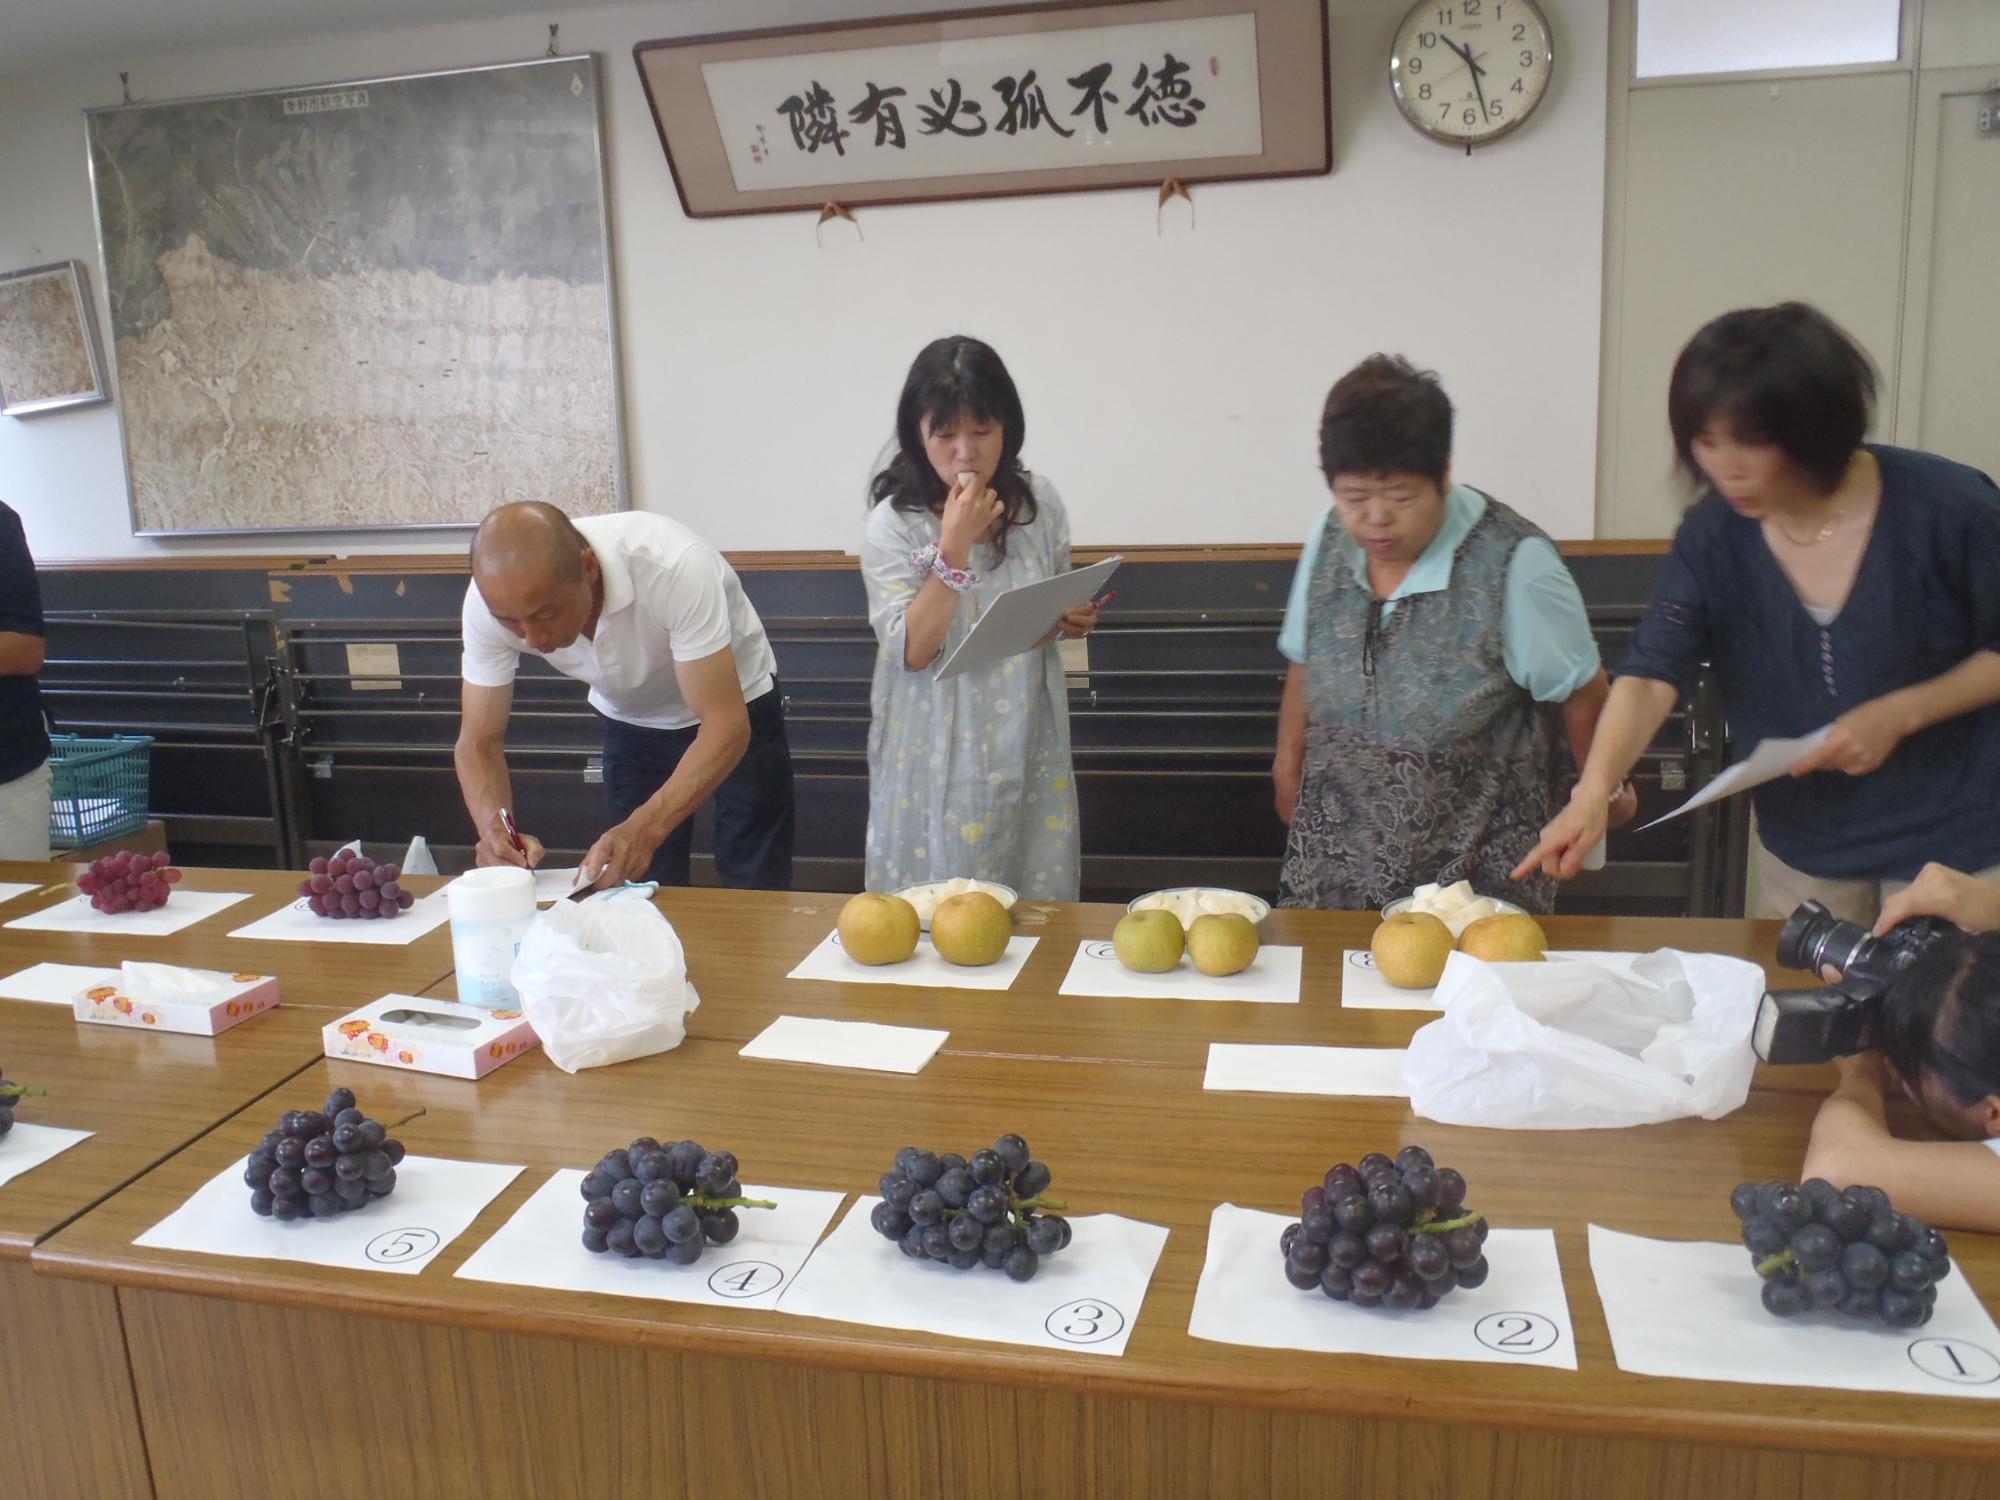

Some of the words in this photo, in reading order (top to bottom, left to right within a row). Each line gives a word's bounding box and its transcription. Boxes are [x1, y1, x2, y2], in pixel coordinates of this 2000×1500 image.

[1463, 0, 1481, 16] 12
[1496, 6, 1501, 20] 1
[1437, 9, 1452, 25] 11
[1417, 32, 1436, 49] 10
[1512, 24, 1525, 41] 2
[1408, 58, 1422, 74] 9
[1519, 51, 1533, 67] 3
[1419, 83, 1432, 100] 8
[1510, 78, 1523, 94] 4
[1439, 103, 1451, 120] 7
[1489, 101, 1503, 116] 5
[1463, 109, 1476, 125] 6
